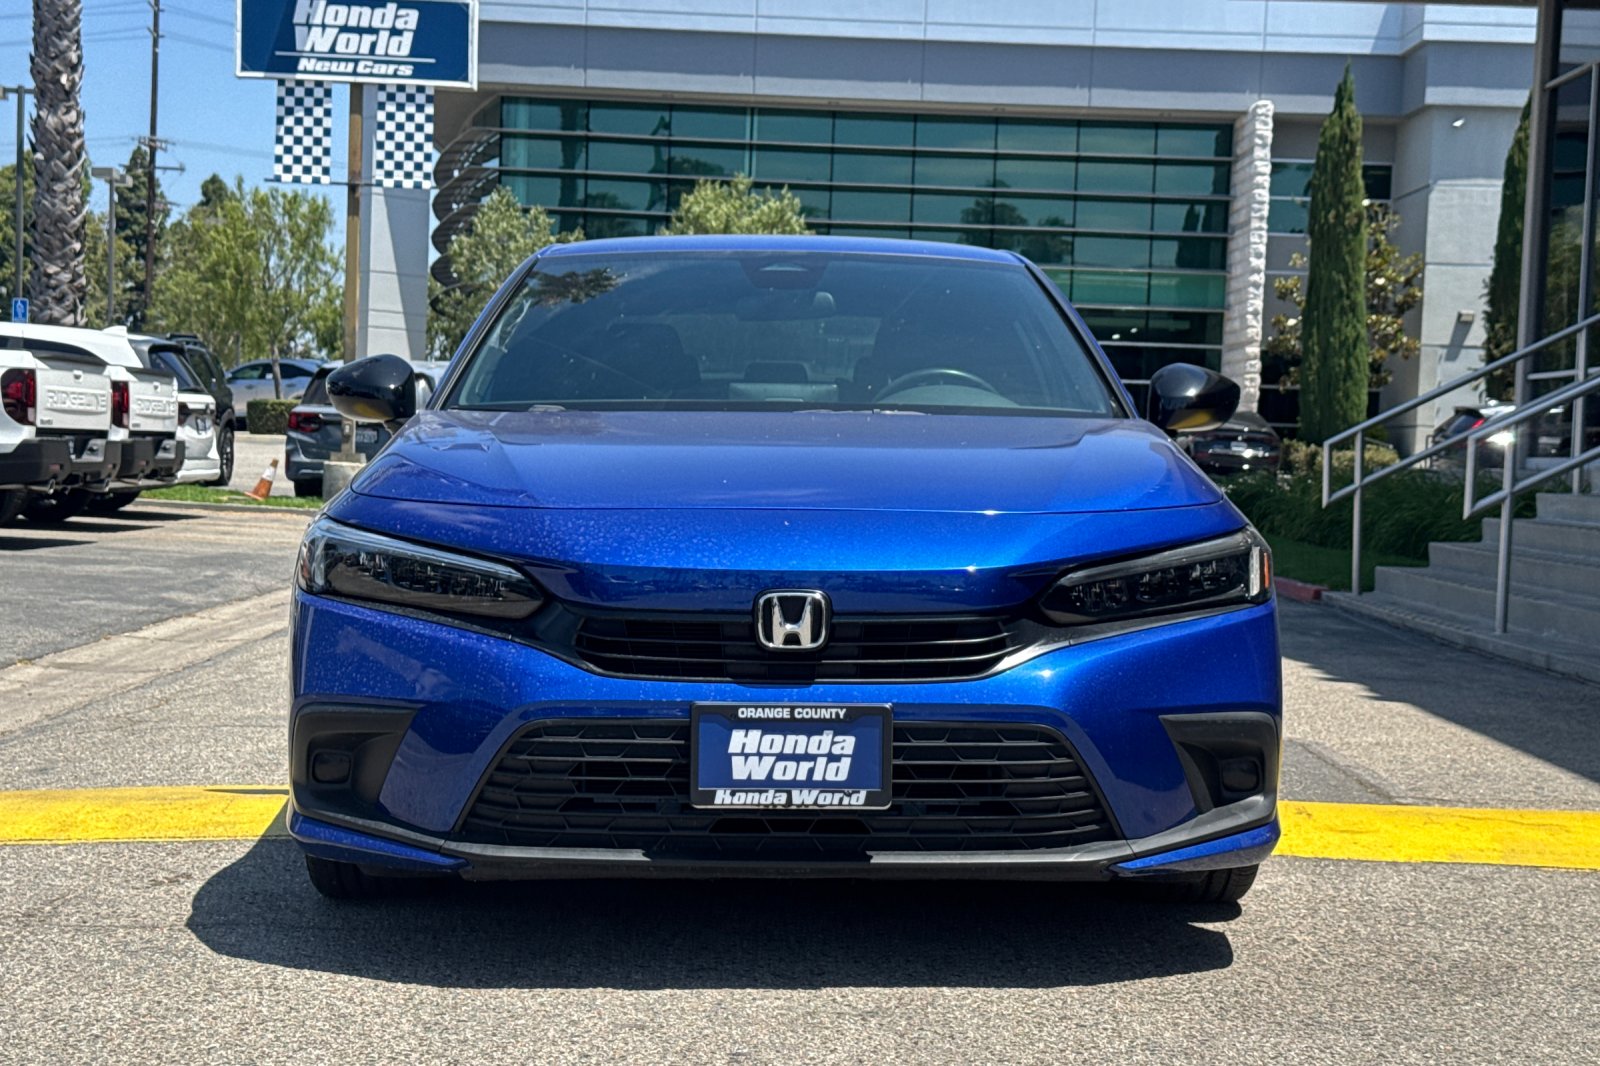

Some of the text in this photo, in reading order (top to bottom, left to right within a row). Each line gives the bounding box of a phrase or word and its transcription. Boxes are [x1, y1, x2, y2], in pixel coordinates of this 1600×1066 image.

[292, 0, 419, 30] Honda
[294, 25, 414, 56] World
[297, 58, 414, 76] New Cars
[737, 707, 847, 719] ORANGE COUNTY
[728, 729, 856, 755] Honda
[731, 756, 852, 781] World
[714, 790, 867, 805] Honda World
